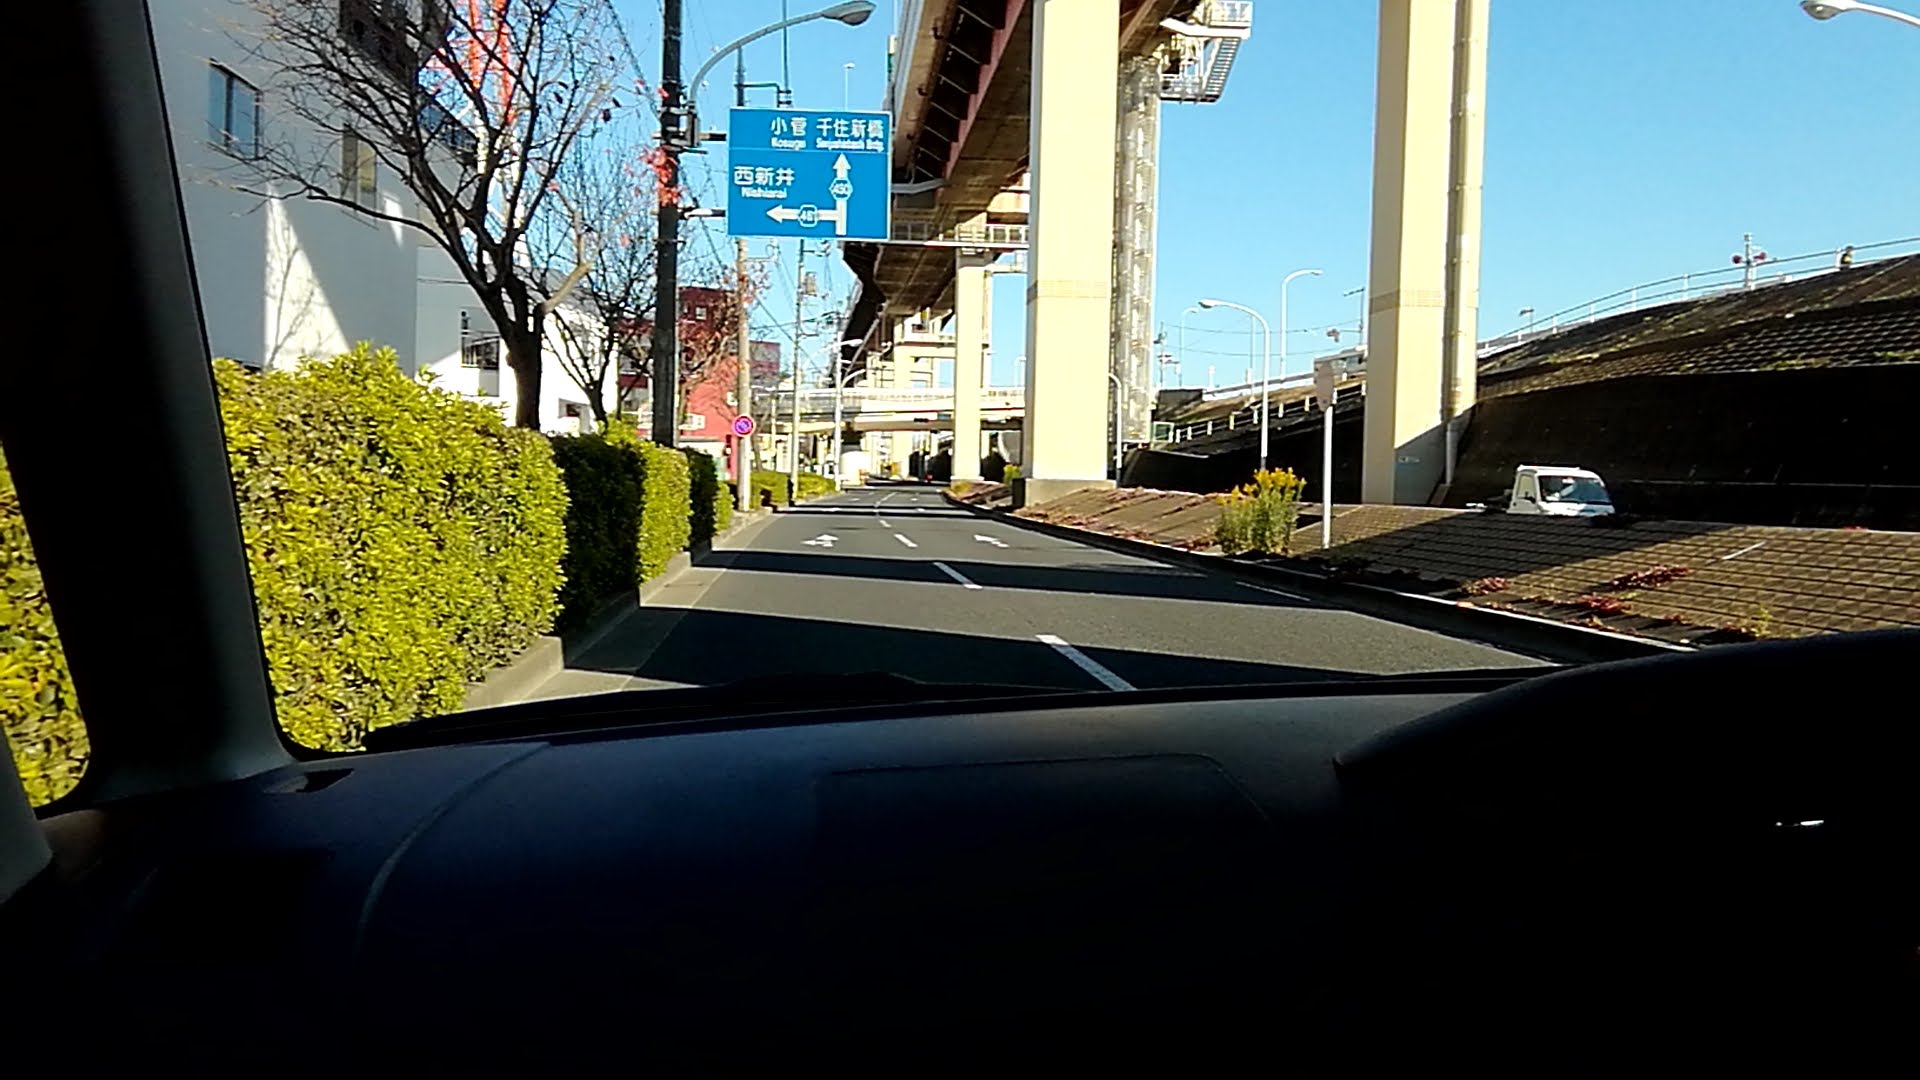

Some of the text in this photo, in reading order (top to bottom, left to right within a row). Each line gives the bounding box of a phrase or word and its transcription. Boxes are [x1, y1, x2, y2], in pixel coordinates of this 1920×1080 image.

[771, 117, 884, 138] 小菅 千住新橋
[734, 166, 795, 186] 西新井
[741, 187, 787, 198] Nishiarai
